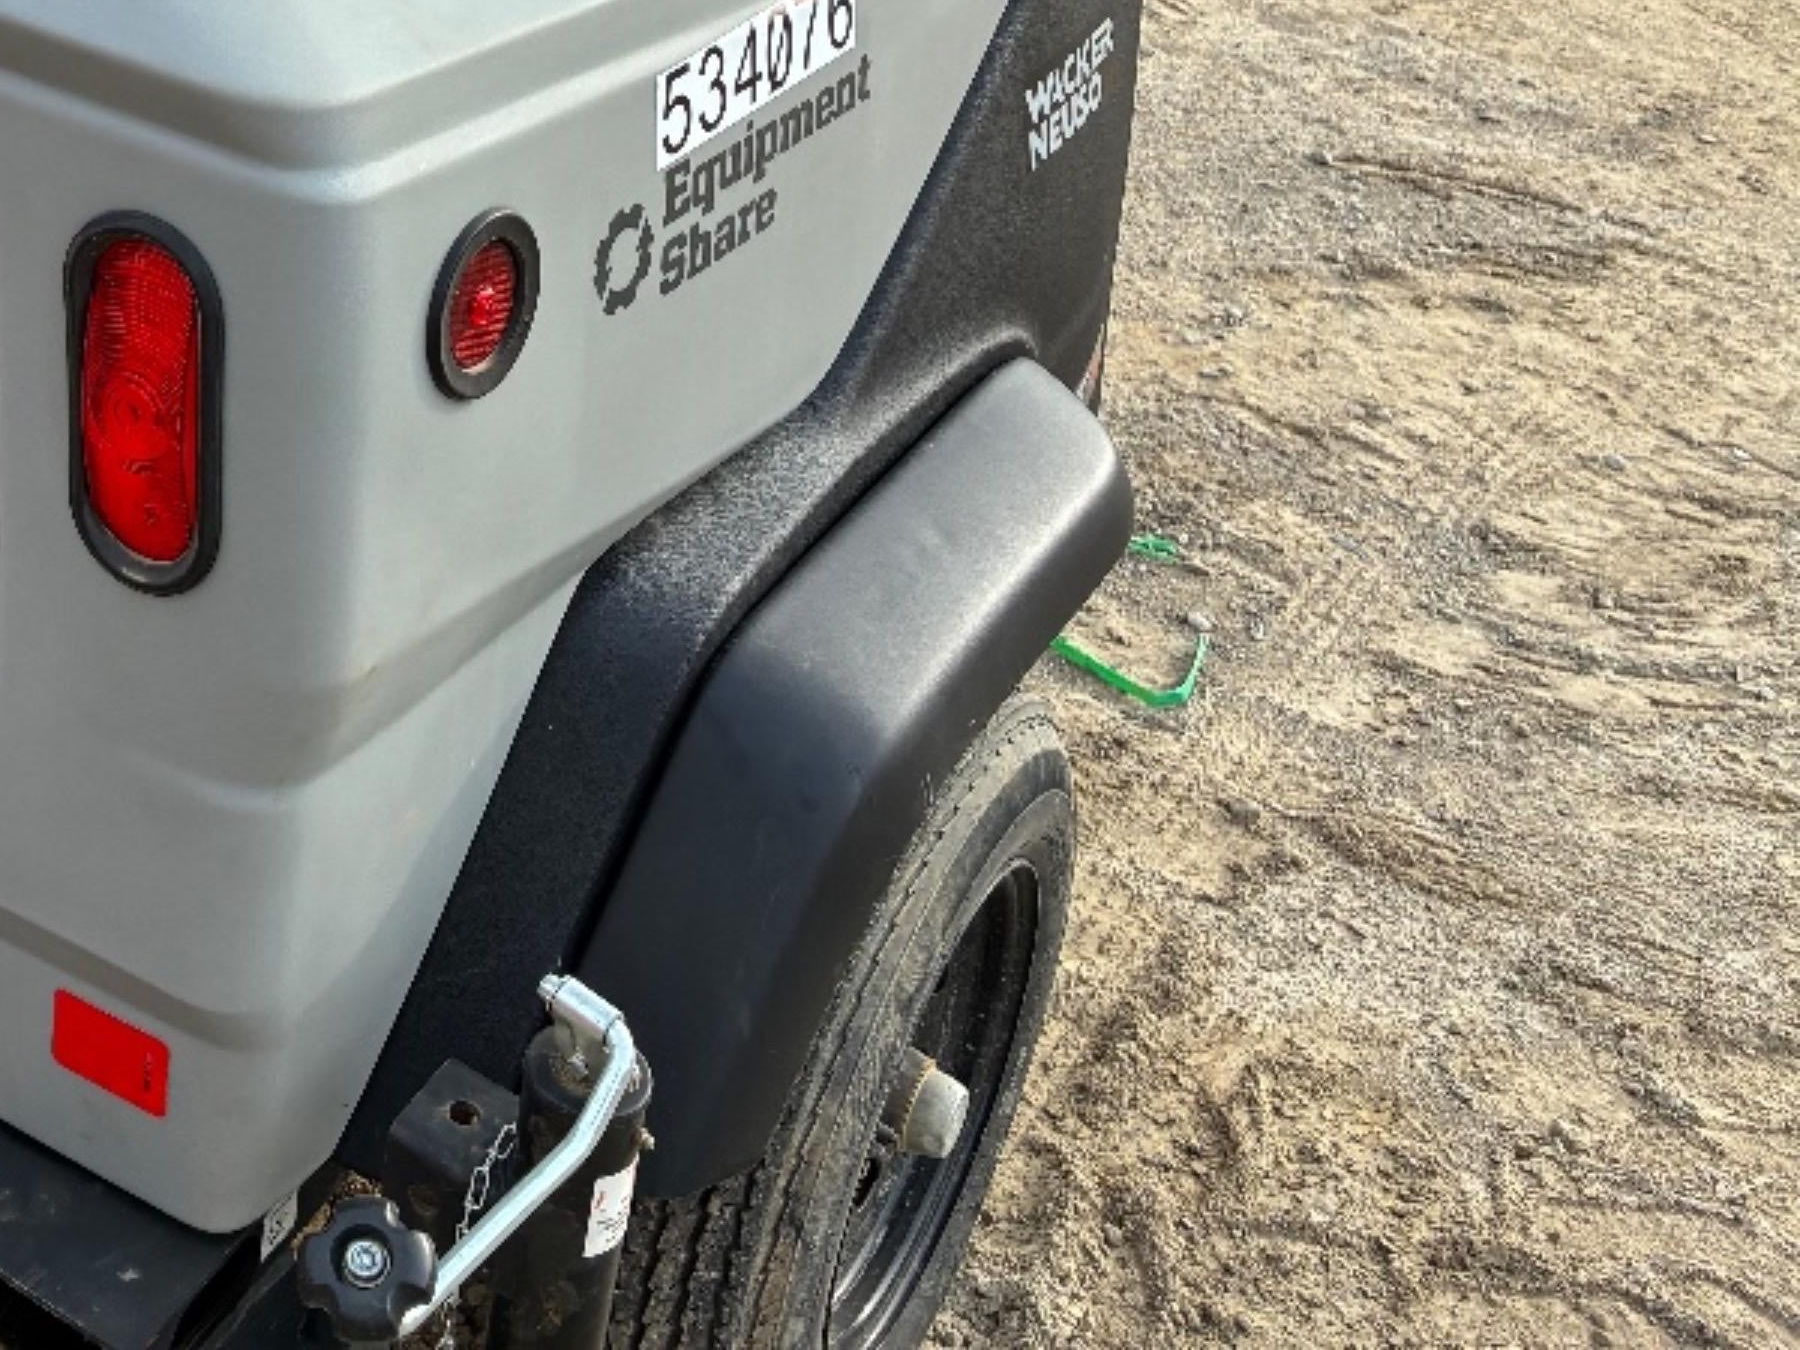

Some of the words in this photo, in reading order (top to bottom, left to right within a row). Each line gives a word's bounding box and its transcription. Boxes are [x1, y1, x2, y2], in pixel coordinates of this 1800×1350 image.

[1024, 16, 1115, 124] WACKER
[662, 52, 873, 229] Equipment
[658, 187, 778, 298] Share
